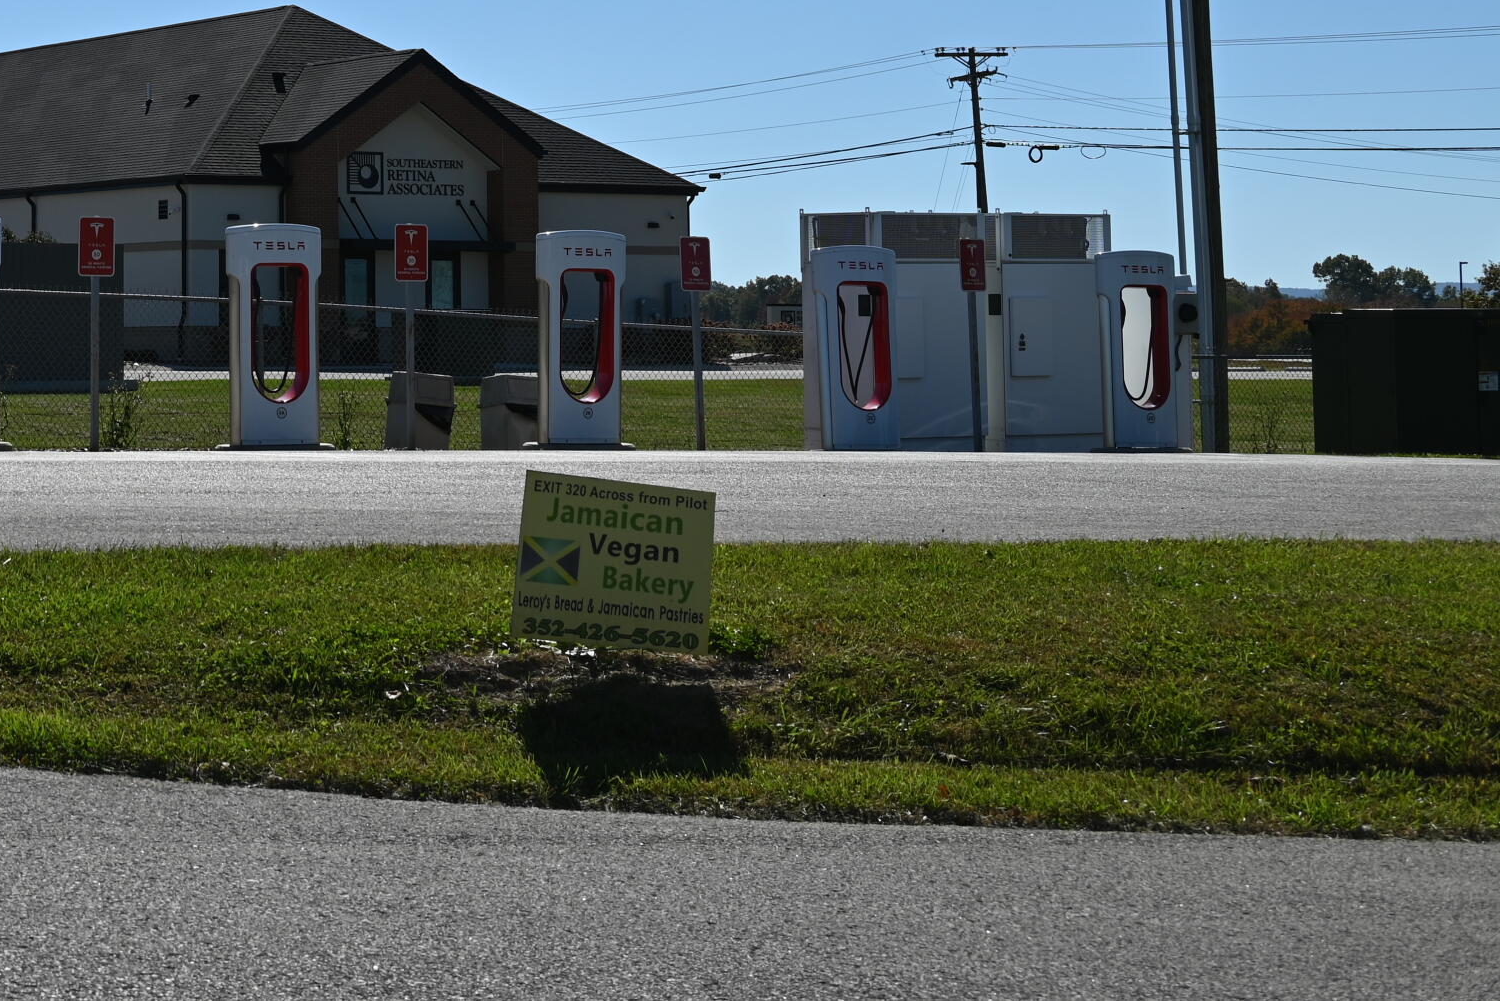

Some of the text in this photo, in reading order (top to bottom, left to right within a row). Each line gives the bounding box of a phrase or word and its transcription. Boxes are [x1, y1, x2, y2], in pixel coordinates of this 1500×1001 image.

[387, 158, 464, 169] SOUTHEASTERN
[388, 169, 436, 182] RETINA
[388, 183, 465, 196] ASSOCIATES
[253, 241, 306, 250] TESLA
[563, 247, 612, 257] TESLA
[837, 261, 884, 270] TESLA
[1121, 265, 1164, 274] TESLA
[534, 479, 708, 511] EXIT 320 Across from Pilot
[546, 497, 684, 536] Jamaican
[589, 532, 680, 566] Vegan
[602, 566, 694, 604] Bakery
[518, 591, 704, 625] Leroy's Bread & Jamaican Pastries
[522, 616, 700, 651] 352-426-5620
